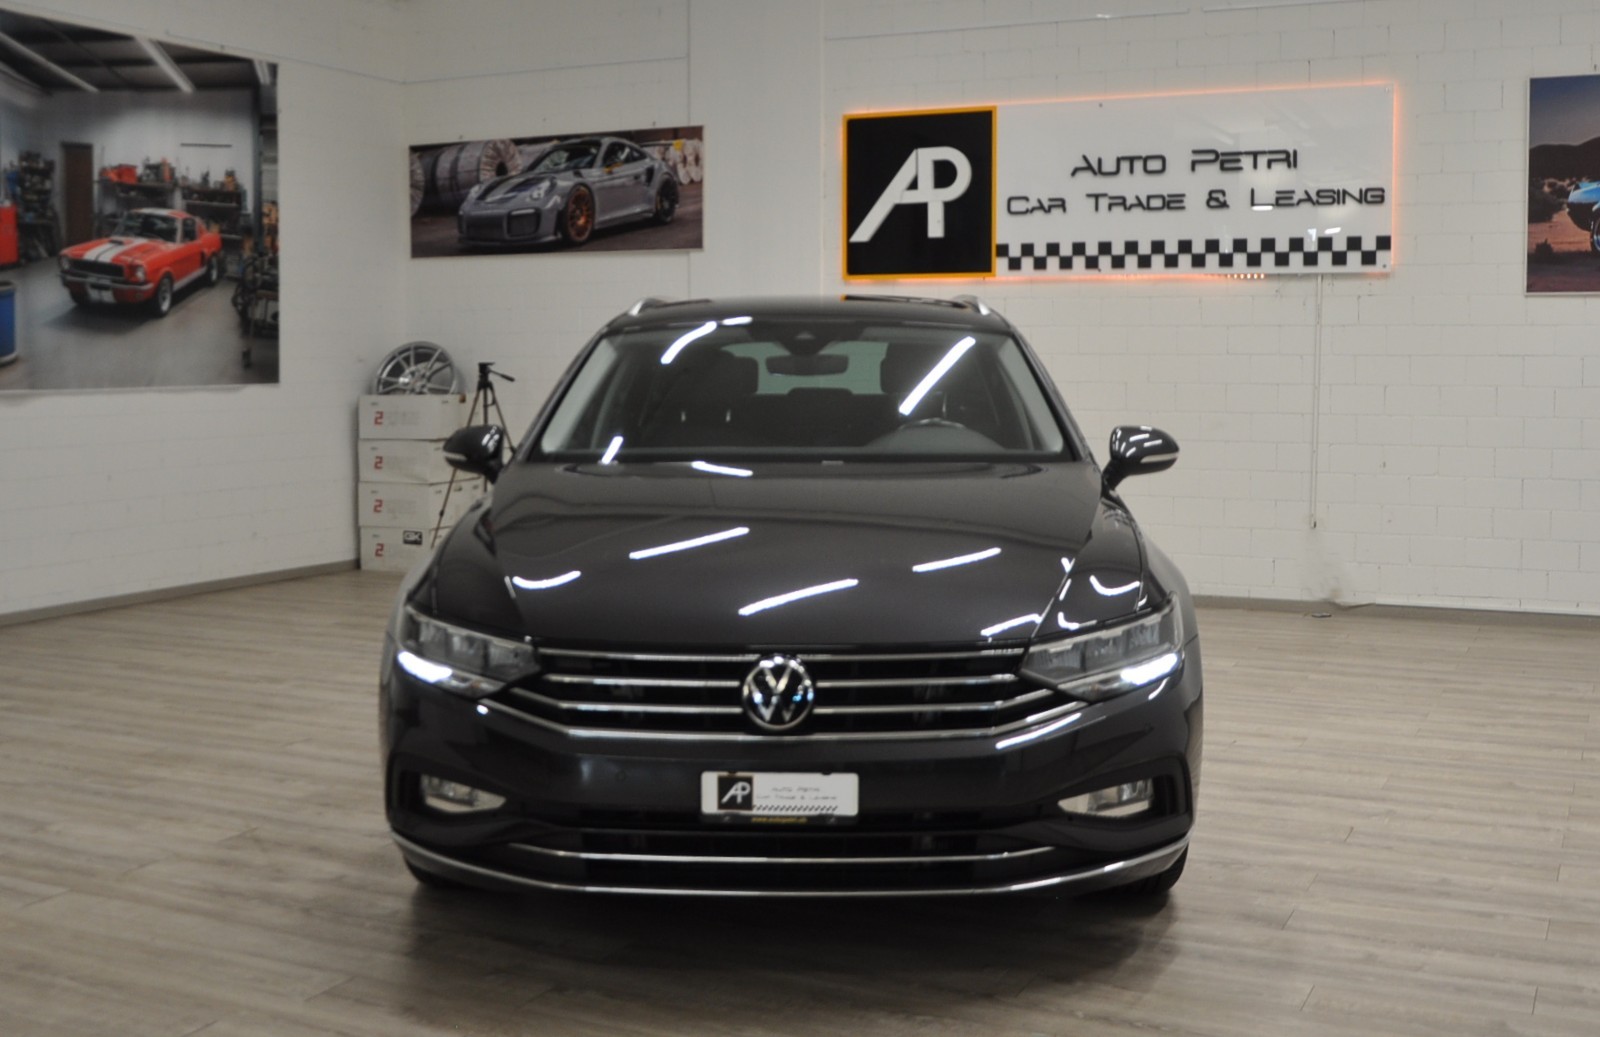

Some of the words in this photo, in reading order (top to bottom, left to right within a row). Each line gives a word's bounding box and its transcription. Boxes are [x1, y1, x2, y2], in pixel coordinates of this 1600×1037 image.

[1071, 153, 1167, 177] AUTO
[1190, 149, 1299, 172] PETRI
[849, 146, 972, 243] AP
[1006, 195, 1067, 216] CAR
[1086, 192, 1187, 212] TRADE
[1206, 190, 1230, 210] &
[1249, 187, 1386, 207] LEASING
